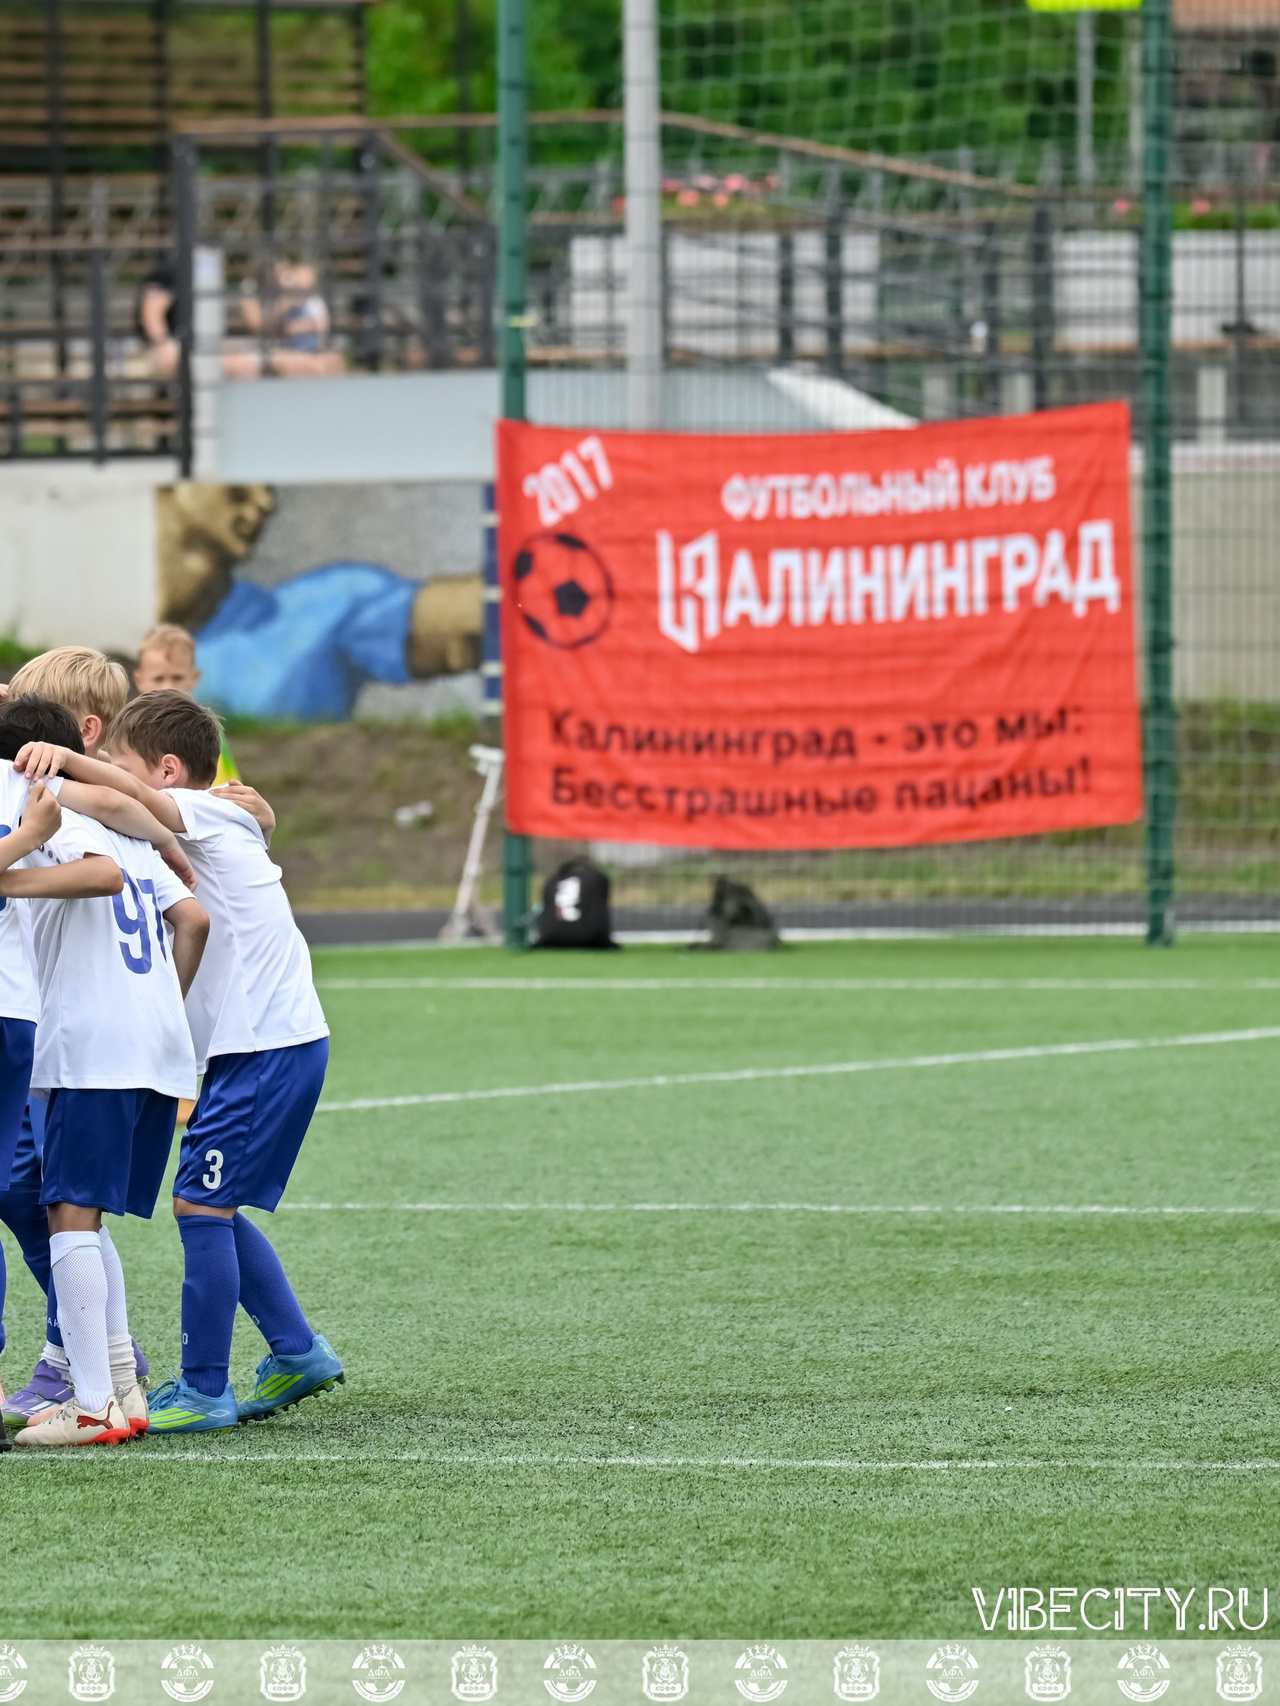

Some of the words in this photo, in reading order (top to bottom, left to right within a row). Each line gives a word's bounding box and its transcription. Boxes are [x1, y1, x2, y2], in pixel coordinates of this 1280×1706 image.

[522, 434, 614, 527] 2017
[721, 457, 961, 520] ФУТБОЛЬНЫЙ
[964, 454, 1056, 508] КЛУБ
[550, 708, 857, 768] Калининград
[904, 720, 978, 753] это
[551, 766, 878, 823] Бесстрашные
[894, 755, 1091, 811] пацаны!
[202, 1149, 224, 1190] 3
